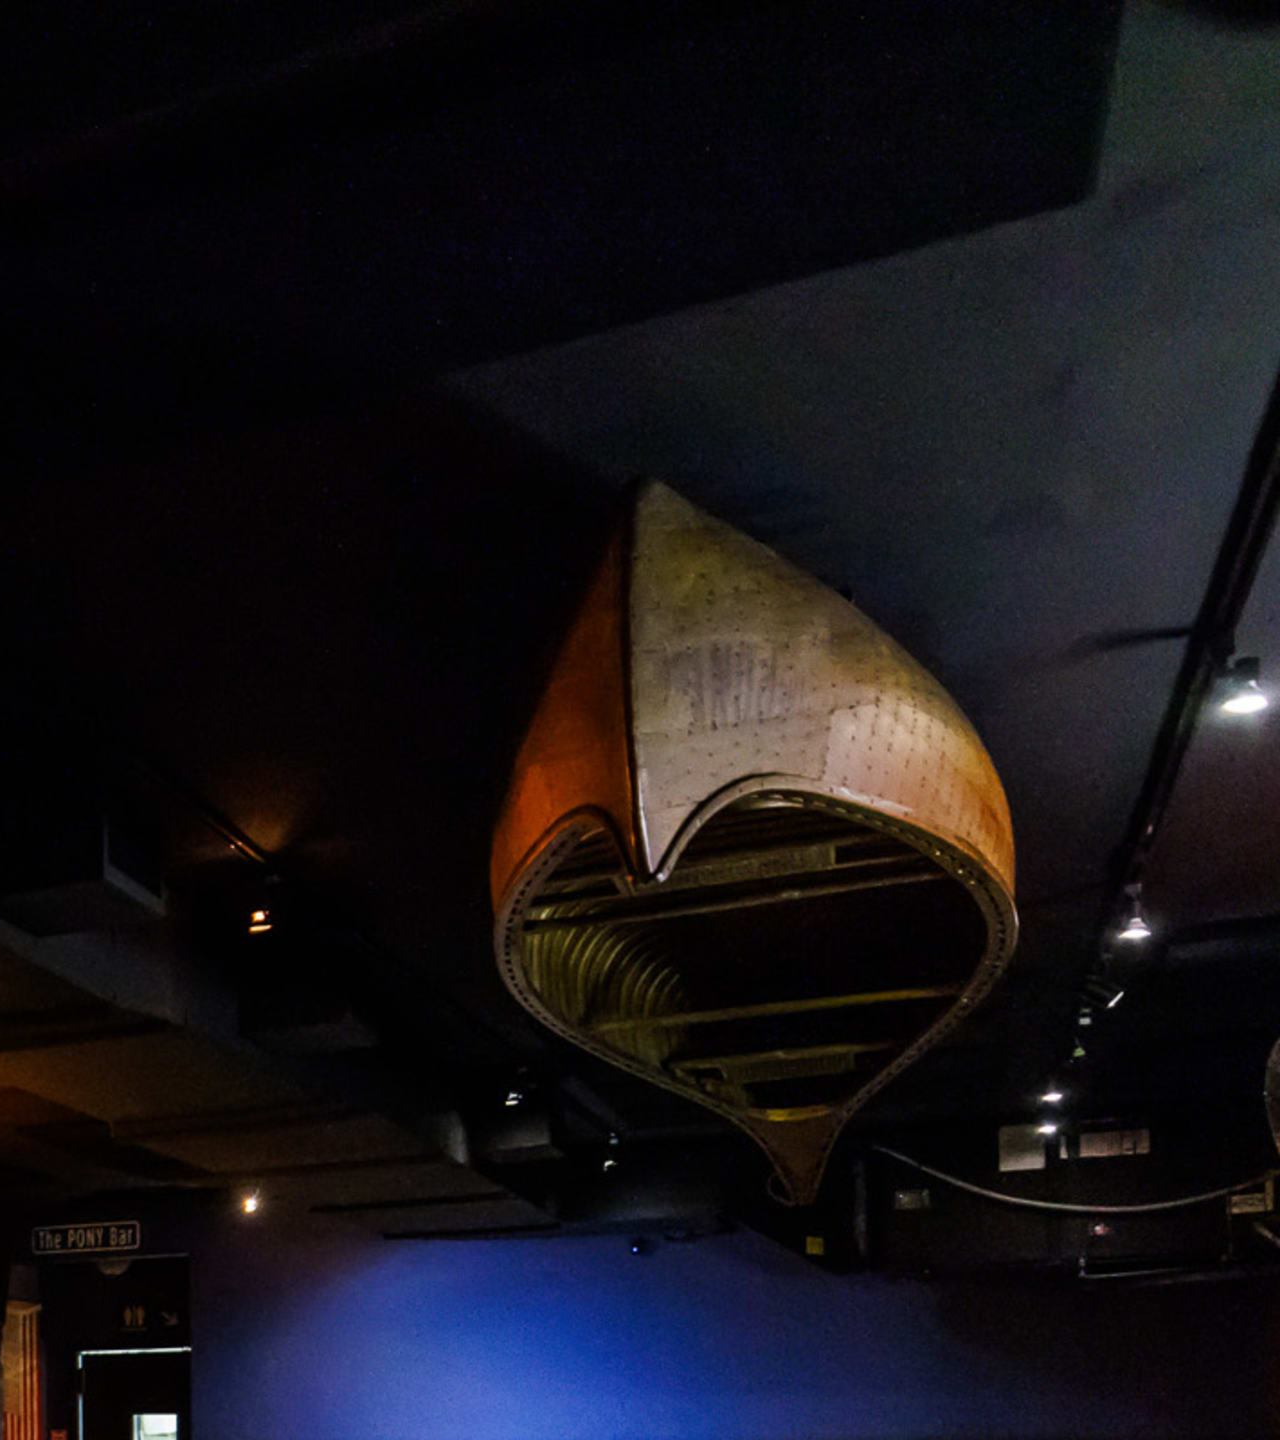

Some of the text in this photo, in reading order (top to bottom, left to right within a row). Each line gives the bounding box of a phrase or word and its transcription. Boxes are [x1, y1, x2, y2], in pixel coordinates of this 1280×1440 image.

[39, 1227, 133, 1249] The PONY Bar
